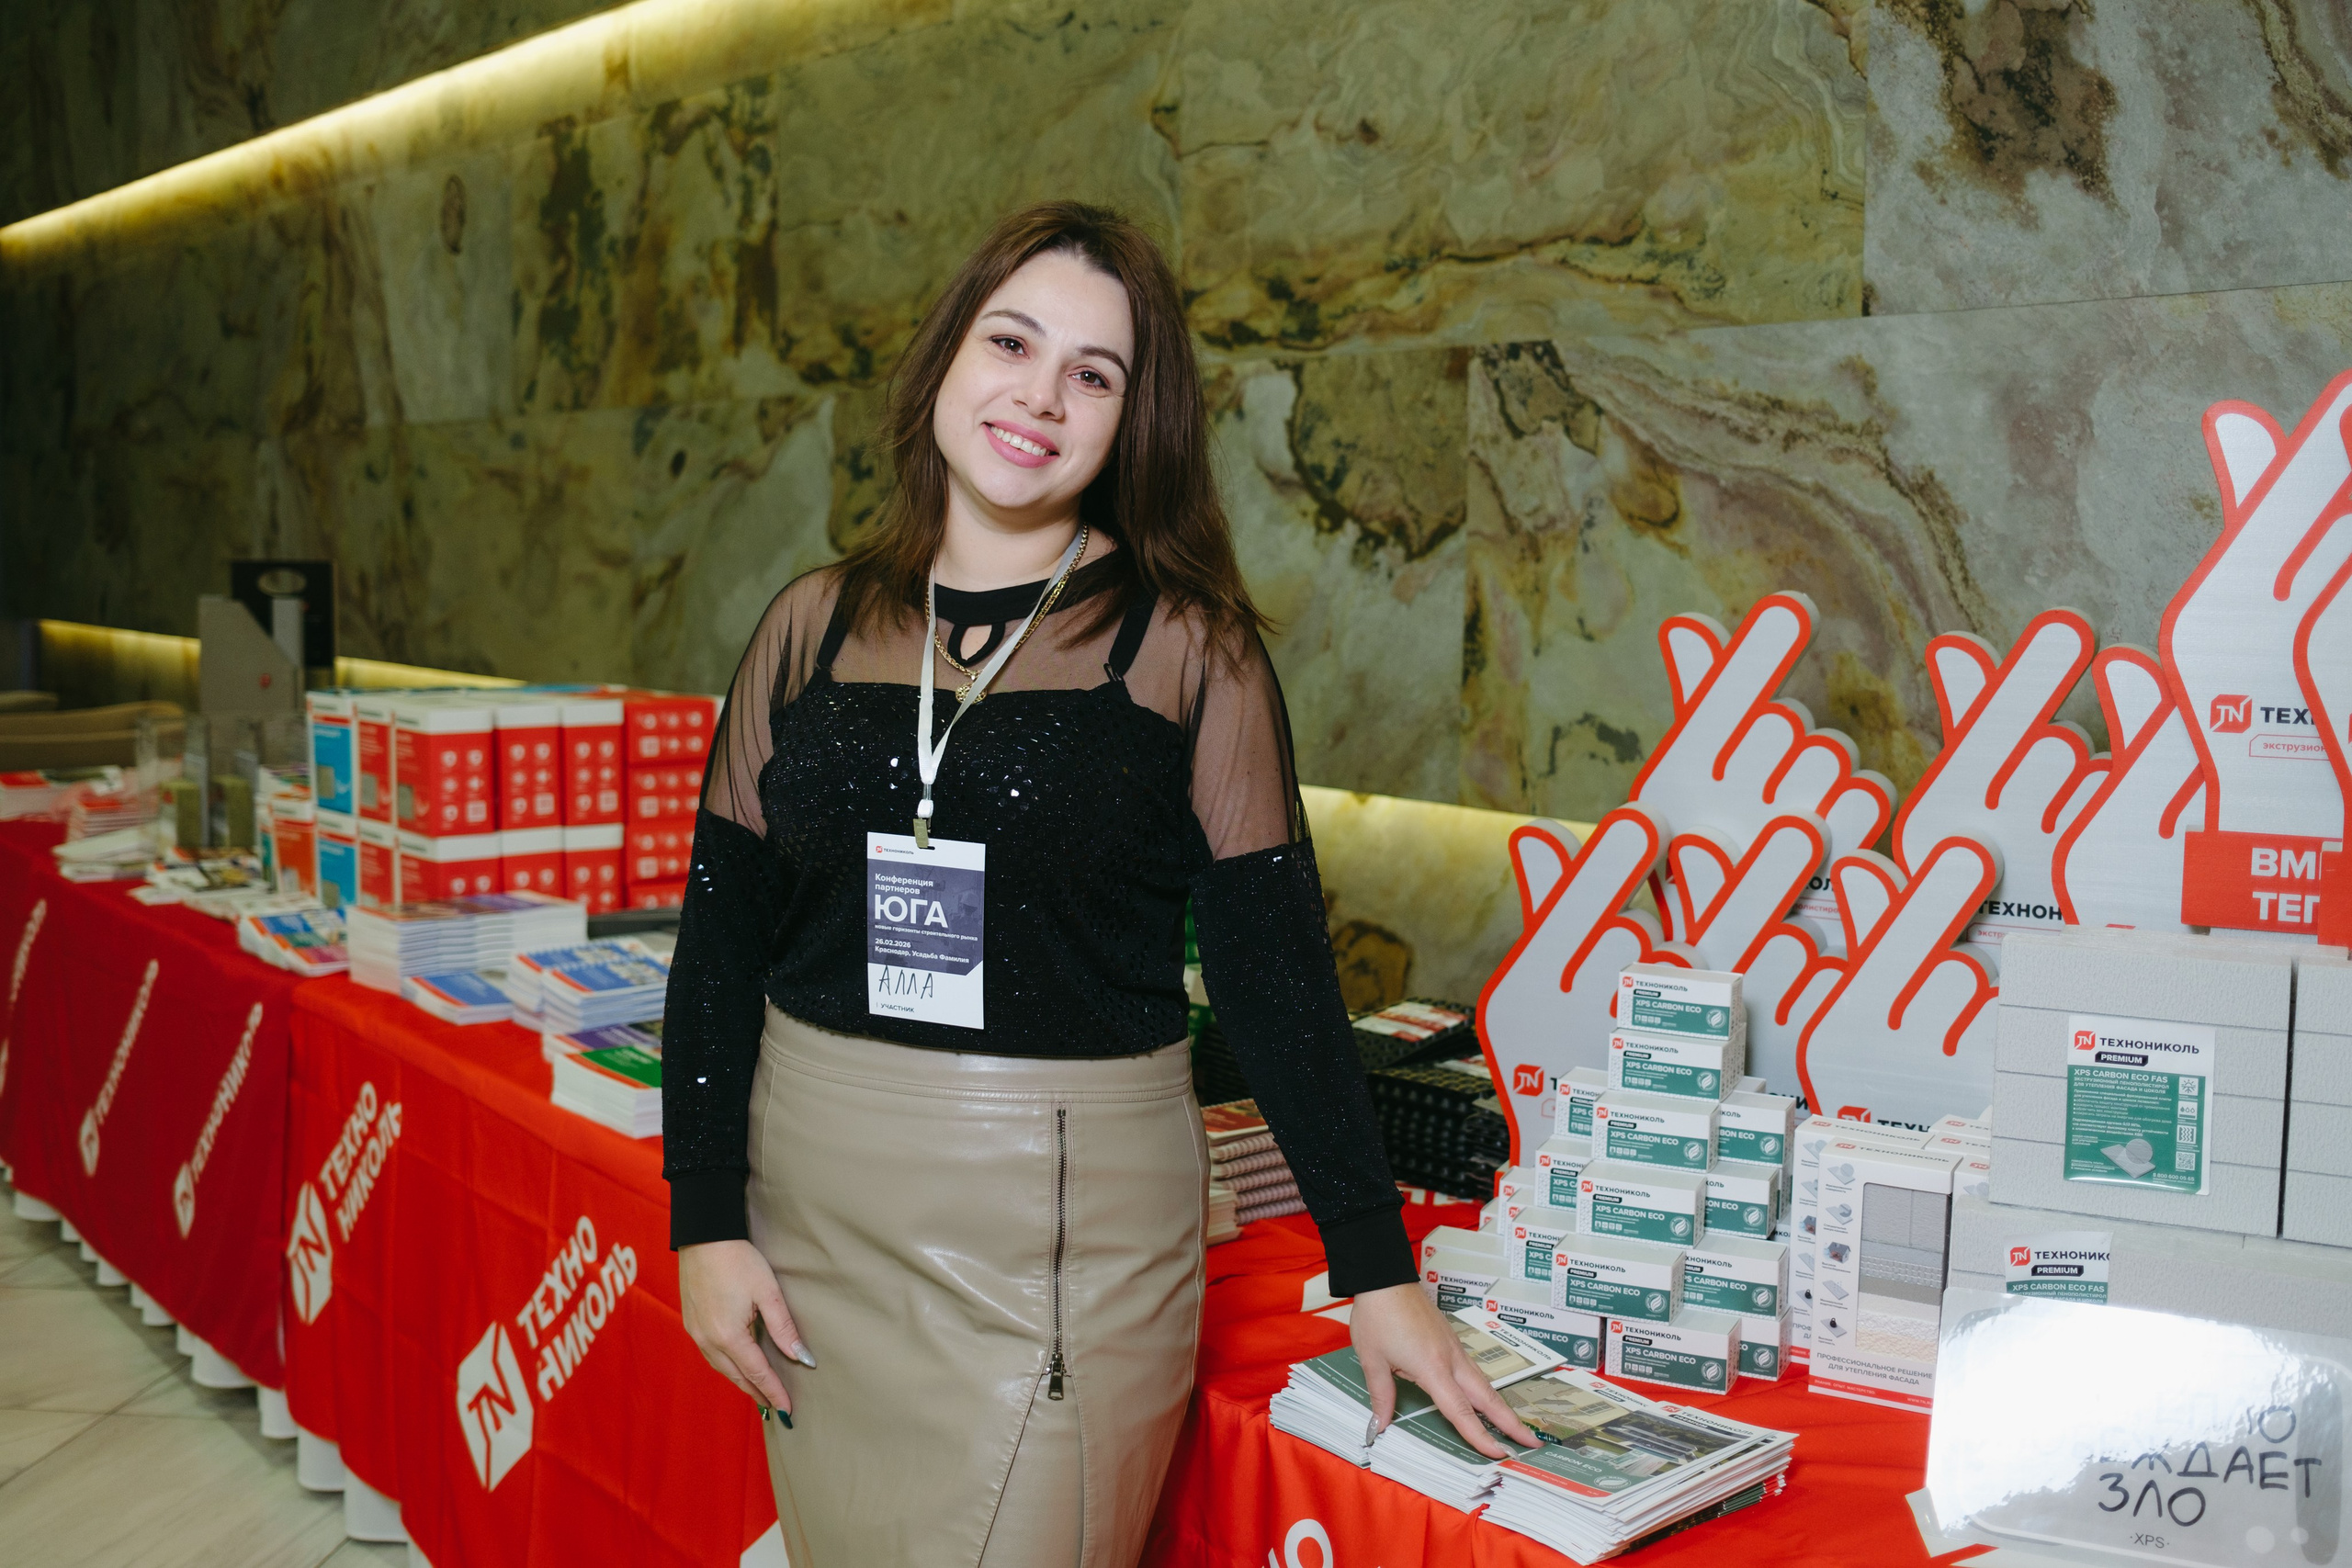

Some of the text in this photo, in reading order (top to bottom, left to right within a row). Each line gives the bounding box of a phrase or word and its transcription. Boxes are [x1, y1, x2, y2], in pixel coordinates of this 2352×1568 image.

[875, 874, 933, 887] Конференция
[875, 884, 921, 895] партнеров
[875, 894, 948, 929] ЮГА
[892, 926, 921, 934] горизонты
[922, 930, 960, 939] строительного
[875, 938, 911, 948] 26.02.2026
[875, 946, 969, 964] Краснодар, Усадьба Фамилия
[878, 964, 933, 999] АЛЛА
[1635, 980, 1688, 992] ТЕХНОНИКОЛЬ
[880, 1003, 915, 1013] УЧАСТНИК
[1635, 998, 1650, 1008] XPS
[1652, 1000, 1684, 1011] CARBON
[1685, 1005, 1702, 1014] ECO
[1625, 1042, 1679, 1055] ТЕХНОНИКОЛЬ
[2099, 1037, 2200, 1055] ТЕХНОНИКОЛЬ
[2100, 1054, 2143, 1064] PREMIUM
[1625, 1061, 1641, 1069] XPS
[1642, 1063, 1675, 1074] CARBON
[1676, 1066, 1692, 1076] ECO
[2074, 1068, 2168, 1084] XPS CARBON ECO FAS
[2120, 1080, 2170, 1089] ПЕНОПОЛИСТИРОЛ
[1611, 1111, 1665, 1123] ТЕХНОНИКОЛЬ
[318, 1080, 378, 1201] ТЕХНО
[1611, 1131, 1626, 1139] XPS
[1627, 1133, 1660, 1144] CARBON
[1662, 1136, 1679, 1146] ECO
[1738, 1131, 1755, 1140] ECO
[1835, 1124, 1921, 1142] ТЕХНОНИКОЛЬ
[1859, 1146, 1951, 1163] ТЕХНОНИКОЛЬ
[1553, 1178, 1568, 1187] XPS
[1596, 1185, 1651, 1198] ТЕХНОНИКОЛЬ
[1595, 1204, 1611, 1213] XPS
[1612, 1207, 1646, 1219] CARBON
[1647, 1211, 1665, 1221] ECO
[1722, 1201, 1738, 1211] ECO
[1529, 1250, 1544, 1259] XPS
[1570, 1258, 1626, 1273] ТЕХНОНИКОЛЬ
[515, 1214, 598, 1350] ТЕХНО
[1570, 1279, 1586, 1288] XPS
[1587, 1281, 1622, 1294] CARBON
[1623, 1288, 1641, 1297] ECO
[1693, 1276, 1747, 1292] CARBON ECO
[2030, 1283, 2066, 1292] CARBON
[2068, 1283, 2086, 1292] ECO
[2087, 1285, 2105, 1293] FAS
[1440, 1294, 1456, 1303] XPS
[1500, 1304, 1555, 1320] ТЕХНОНИКОЛЬ
[536, 1241, 638, 1403] НИКОЛЬ
[1552, 1333, 1569, 1343] ECO
[1624, 1325, 1681, 1341] ТЕХНОНИКОЛЬ
[1499, 1328, 1552, 1361] ТЕХНОНИКОЛЬ
[1625, 1346, 1641, 1356] XPS
[1642, 1348, 1677, 1361] CARBON
[1679, 1355, 1697, 1365] ECO
[1817, 1352, 1896, 1373] ПРОФЕССИОНАЛЬНОЕ
[1897, 1368, 1933, 1380] РЕШЕНИЕ
[1828, 1362, 1920, 1386] ДЛЯ УТЕПЛЕНИЯ ФАСАДА
[1680, 1411, 1755, 1436] ТЕХНОНИКОЛЬ
[1544, 1451, 1602, 1473] CARBON ECO
[2098, 1472, 2207, 1527] ЗЛО
